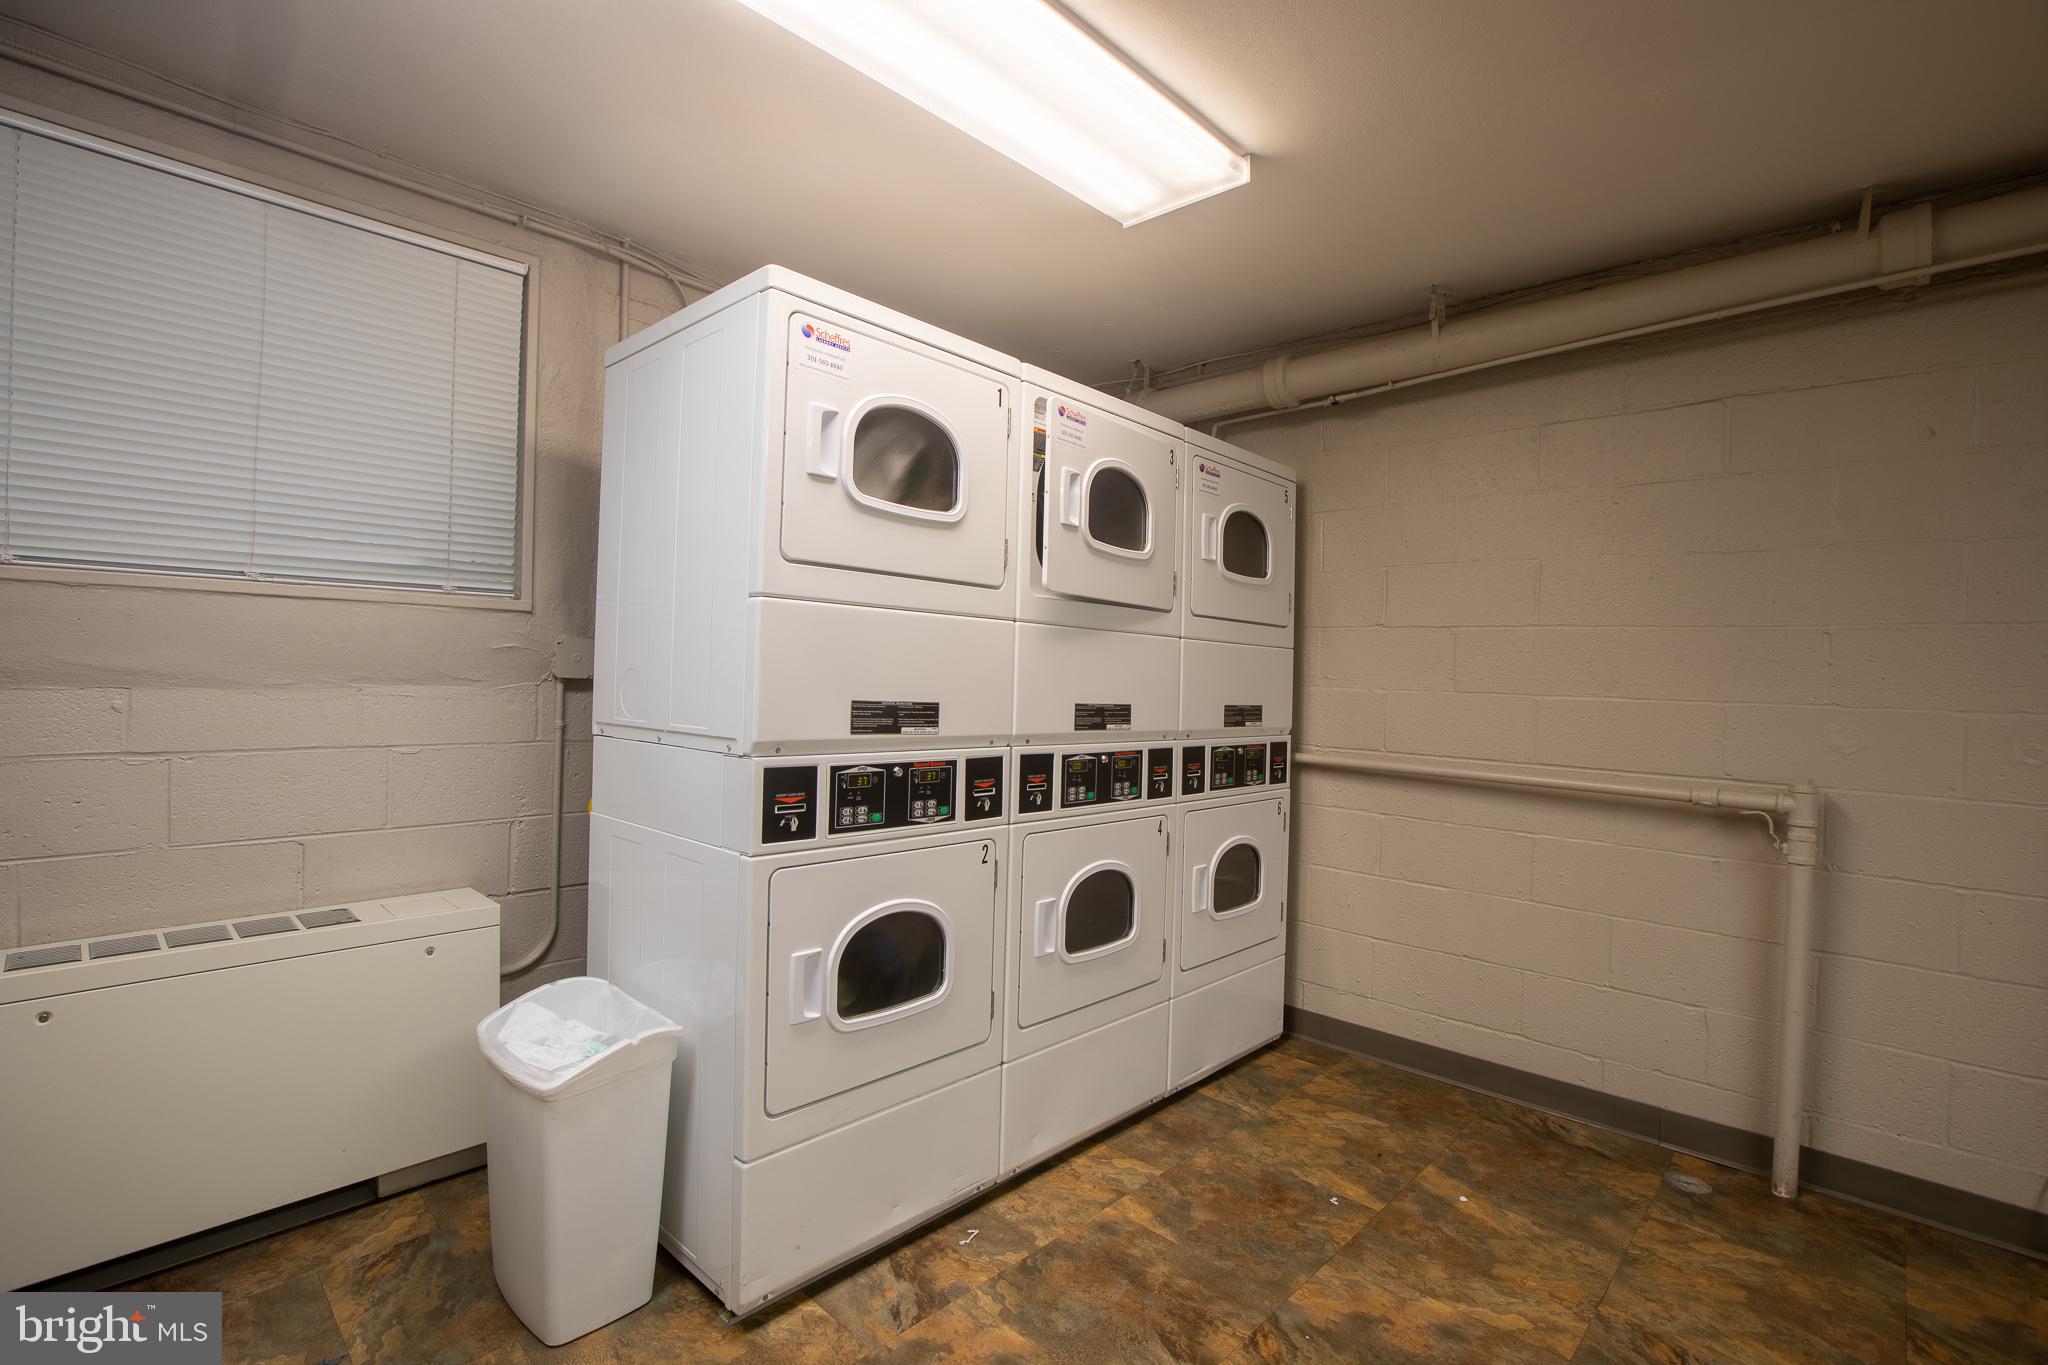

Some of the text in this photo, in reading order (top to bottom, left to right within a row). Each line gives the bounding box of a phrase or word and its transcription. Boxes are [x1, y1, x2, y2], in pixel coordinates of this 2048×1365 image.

[815, 327, 851, 347] Scheffres
[997, 387, 1003, 408] 1
[1169, 449, 1175, 466] 3
[1284, 489, 1289, 504] 5
[857, 777, 868, 786] 37
[927, 771, 936, 780] 37
[1277, 801, 1282, 816] 6
[1157, 819, 1163, 837] 4
[981, 844, 989, 865] 2
